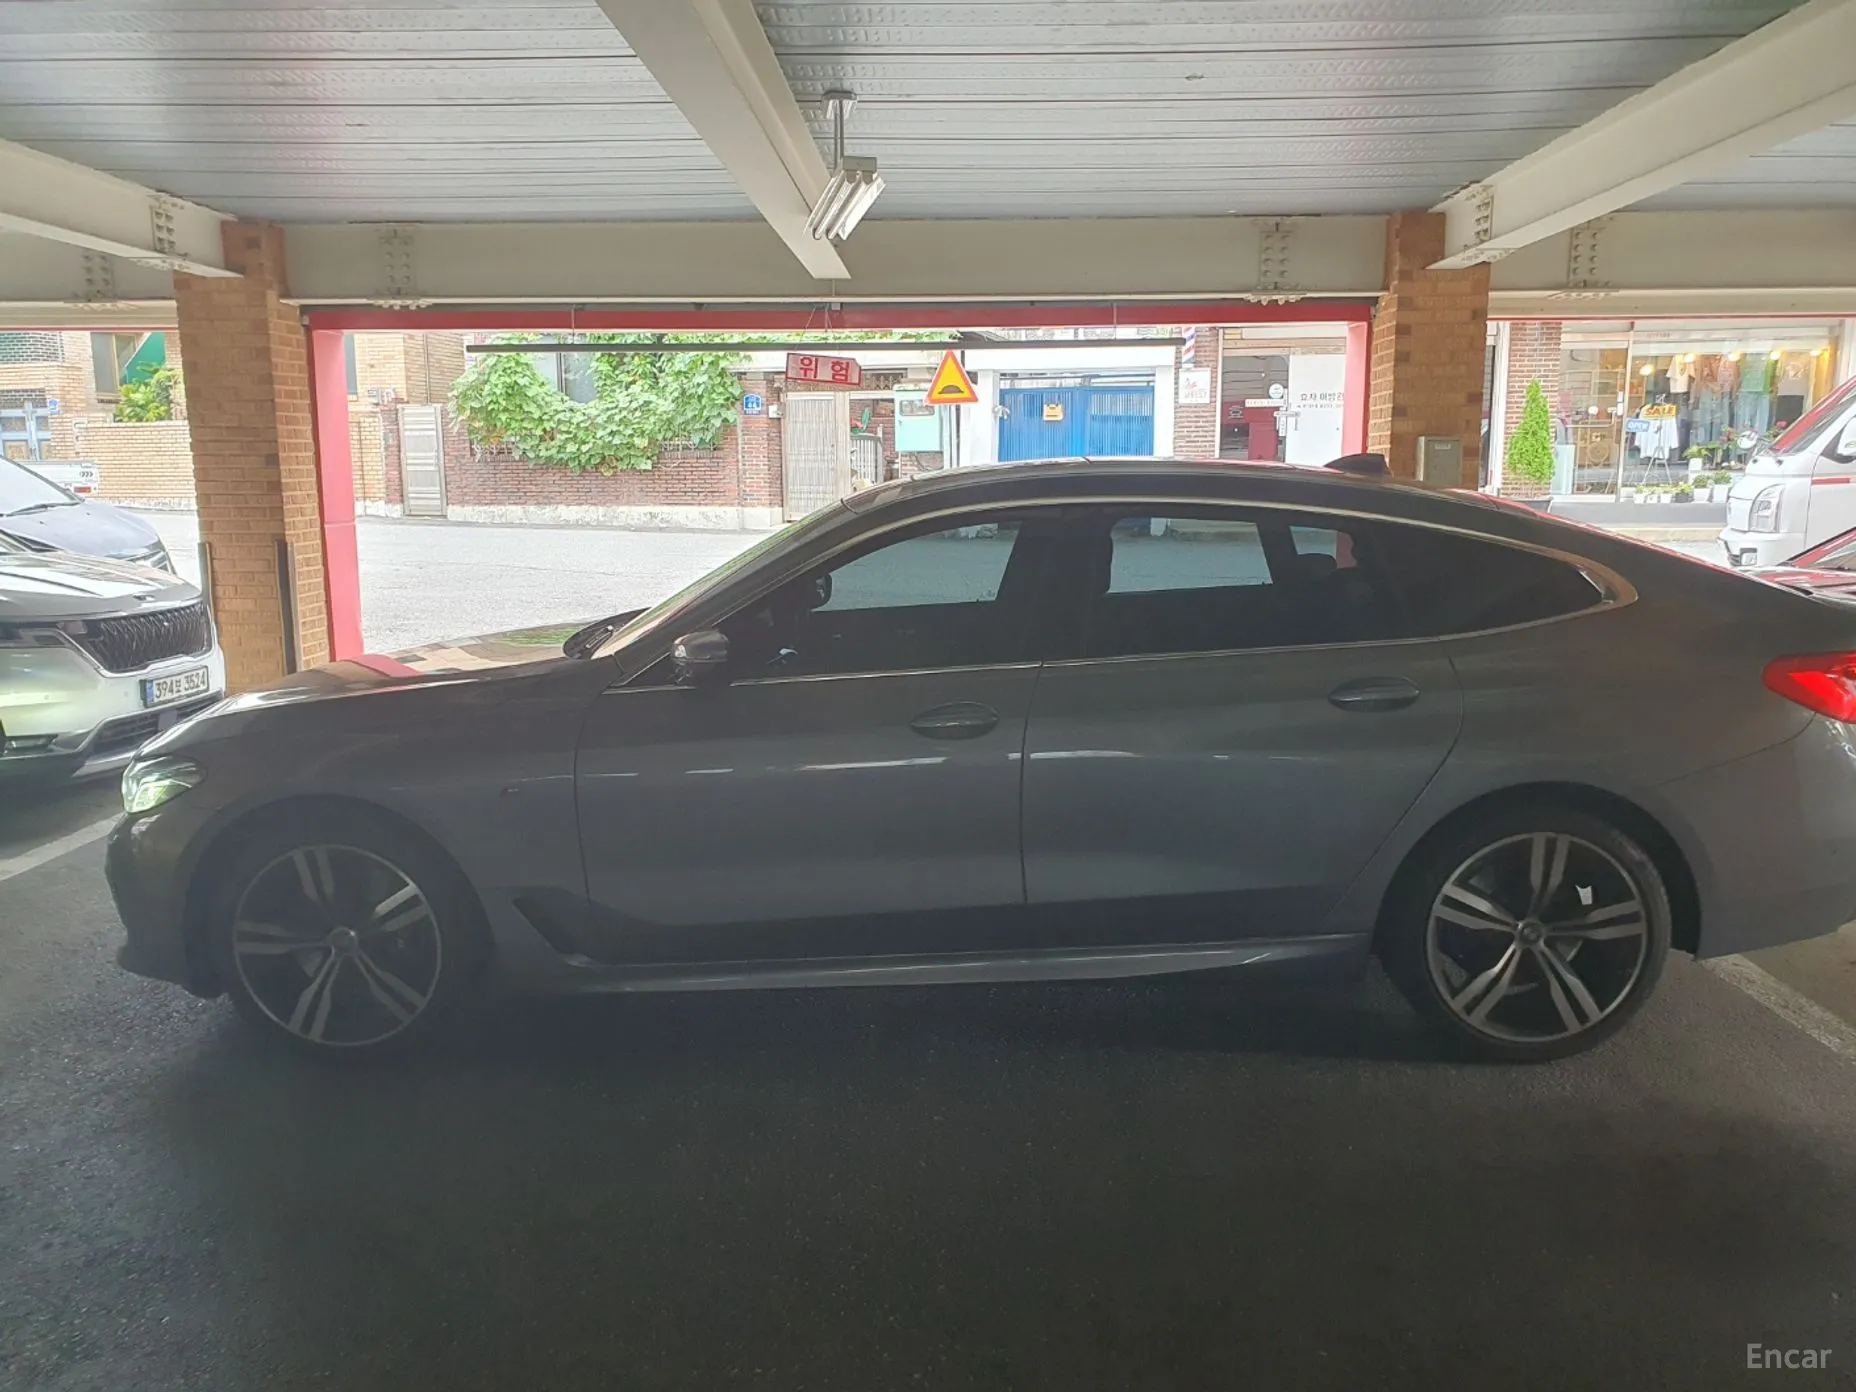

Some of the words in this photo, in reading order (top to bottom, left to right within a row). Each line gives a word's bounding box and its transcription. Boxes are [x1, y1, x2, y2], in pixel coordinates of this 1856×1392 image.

[799, 356, 850, 382] 위험
[1644, 404, 1675, 416] SALE
[184, 671, 206, 691] 3524
